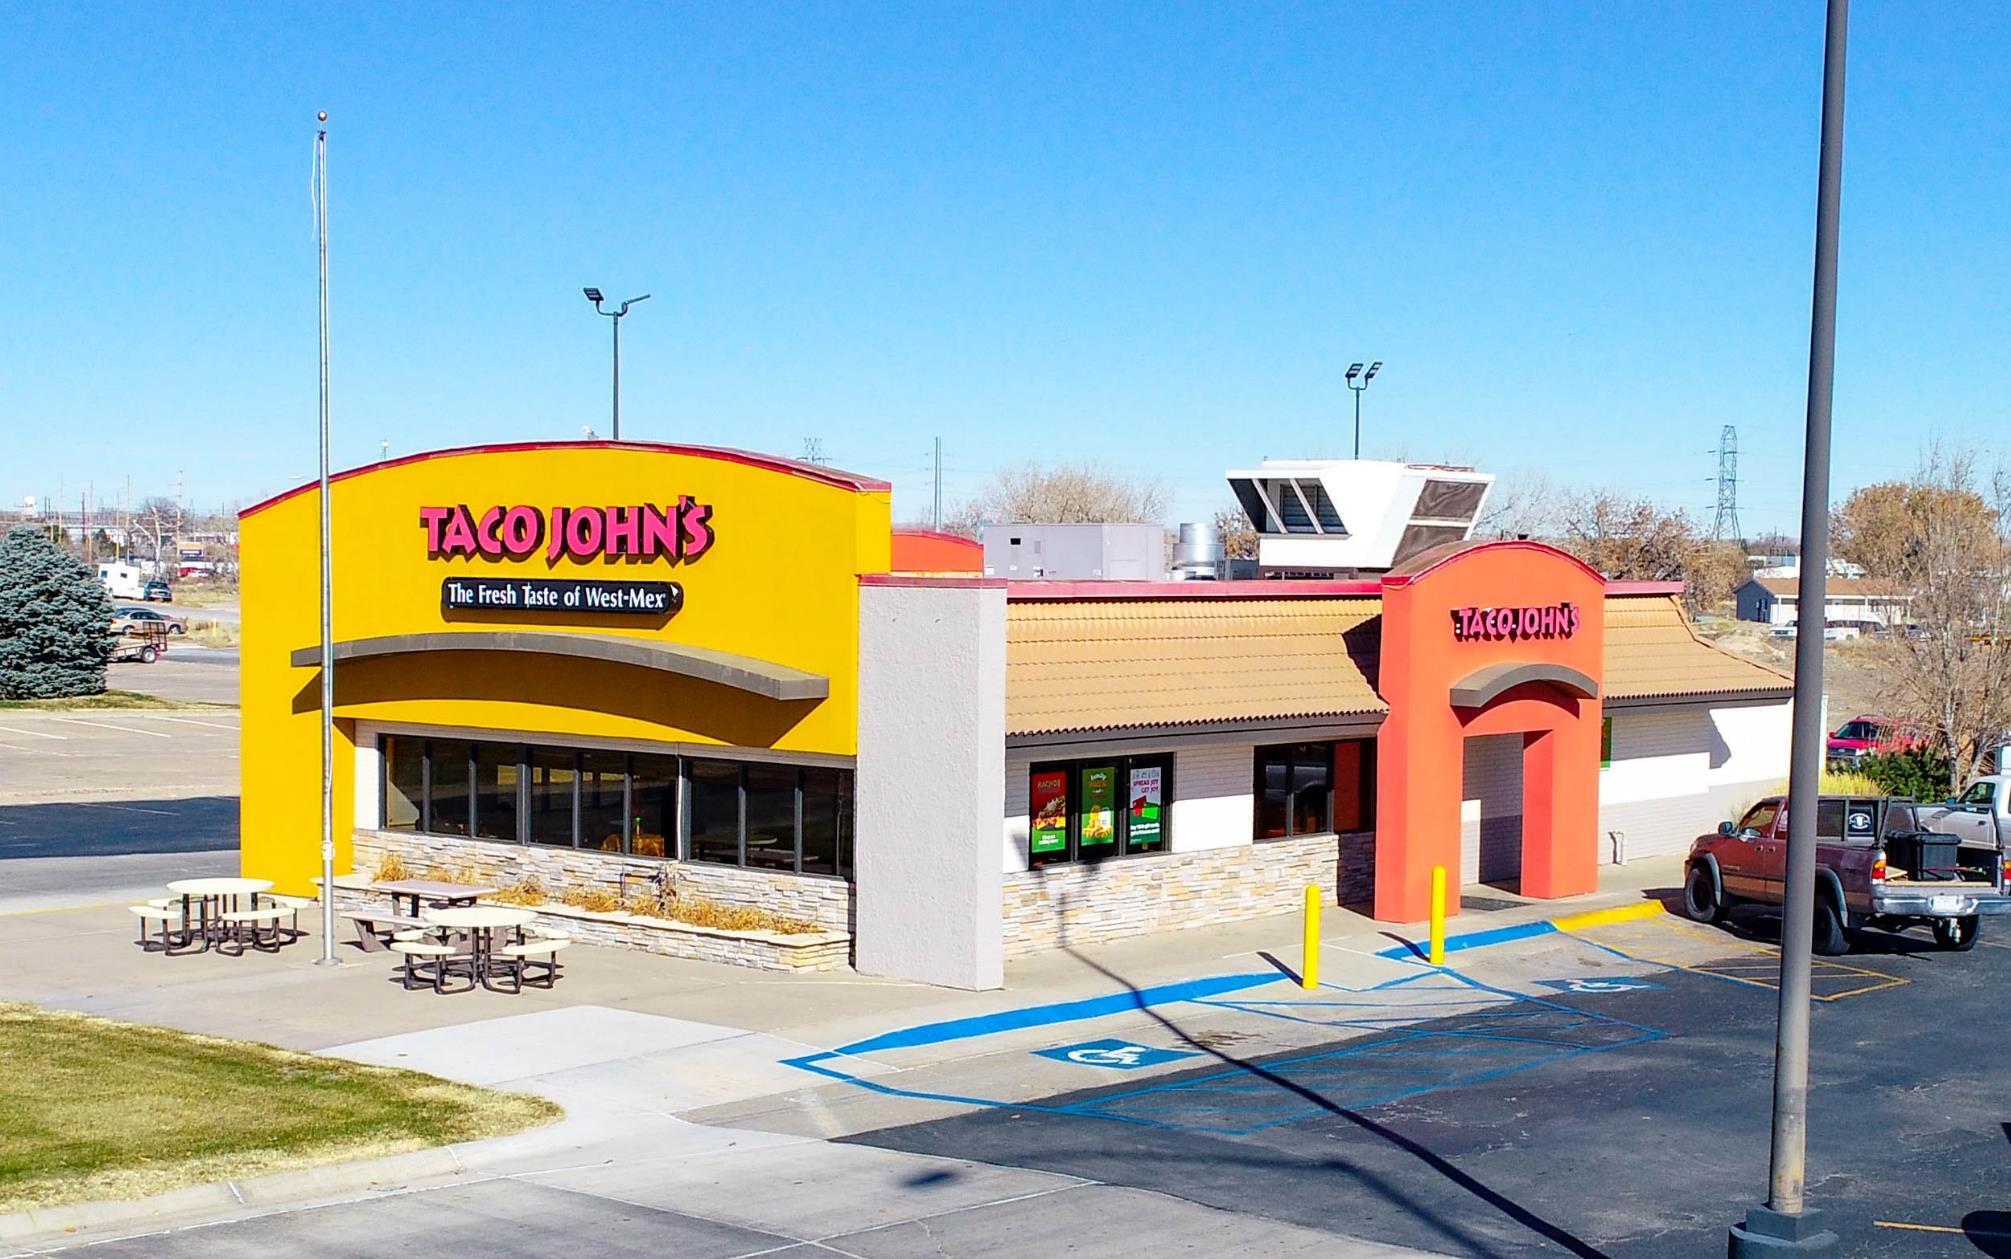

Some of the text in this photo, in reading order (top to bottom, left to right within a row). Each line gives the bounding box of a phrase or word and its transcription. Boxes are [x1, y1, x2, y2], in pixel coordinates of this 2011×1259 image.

[420, 495, 713, 565] TACO JOHN'S
[448, 583, 666, 609] The Fresh Taste of West-Mex
[1454, 602, 1581, 639] TACO JOHN'S
